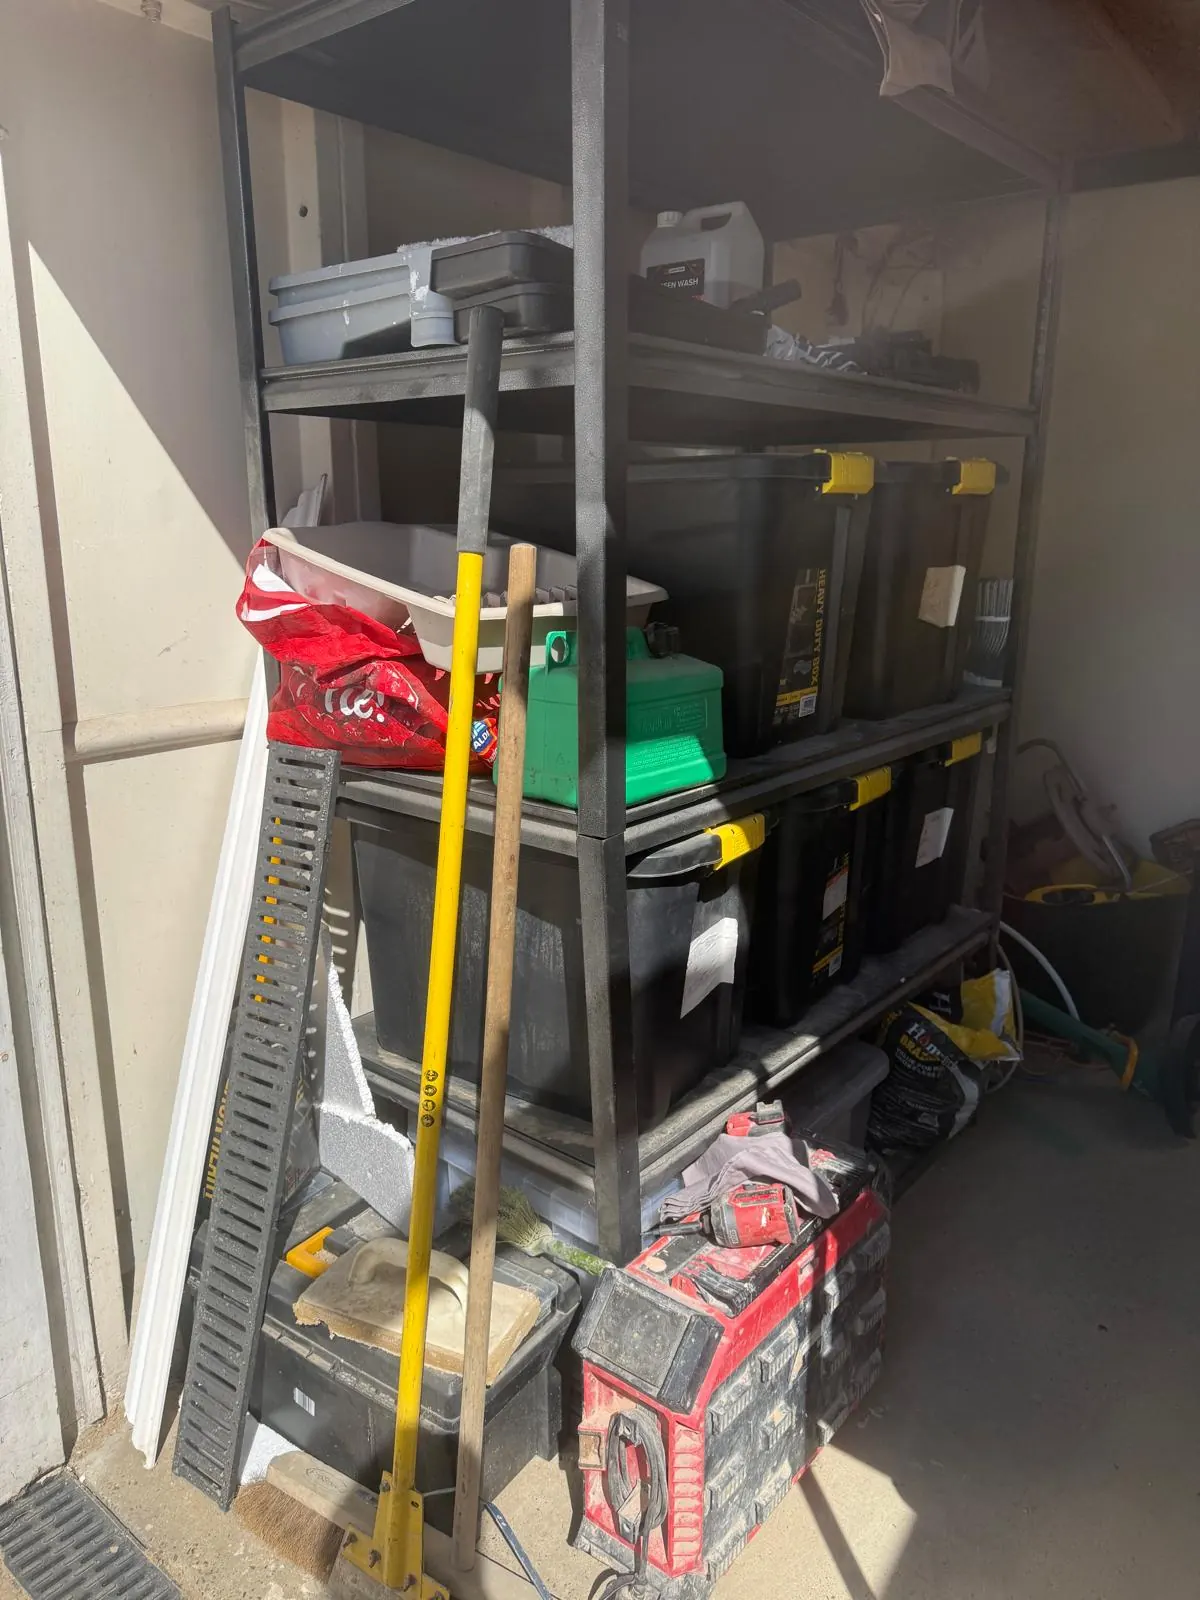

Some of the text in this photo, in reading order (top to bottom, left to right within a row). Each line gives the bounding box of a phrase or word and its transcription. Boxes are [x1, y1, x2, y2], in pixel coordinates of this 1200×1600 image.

[677, 277, 698, 287] WASH
[811, 569, 826, 686] HEAVY DUTY BOX
[473, 730, 490, 750] ALDI
